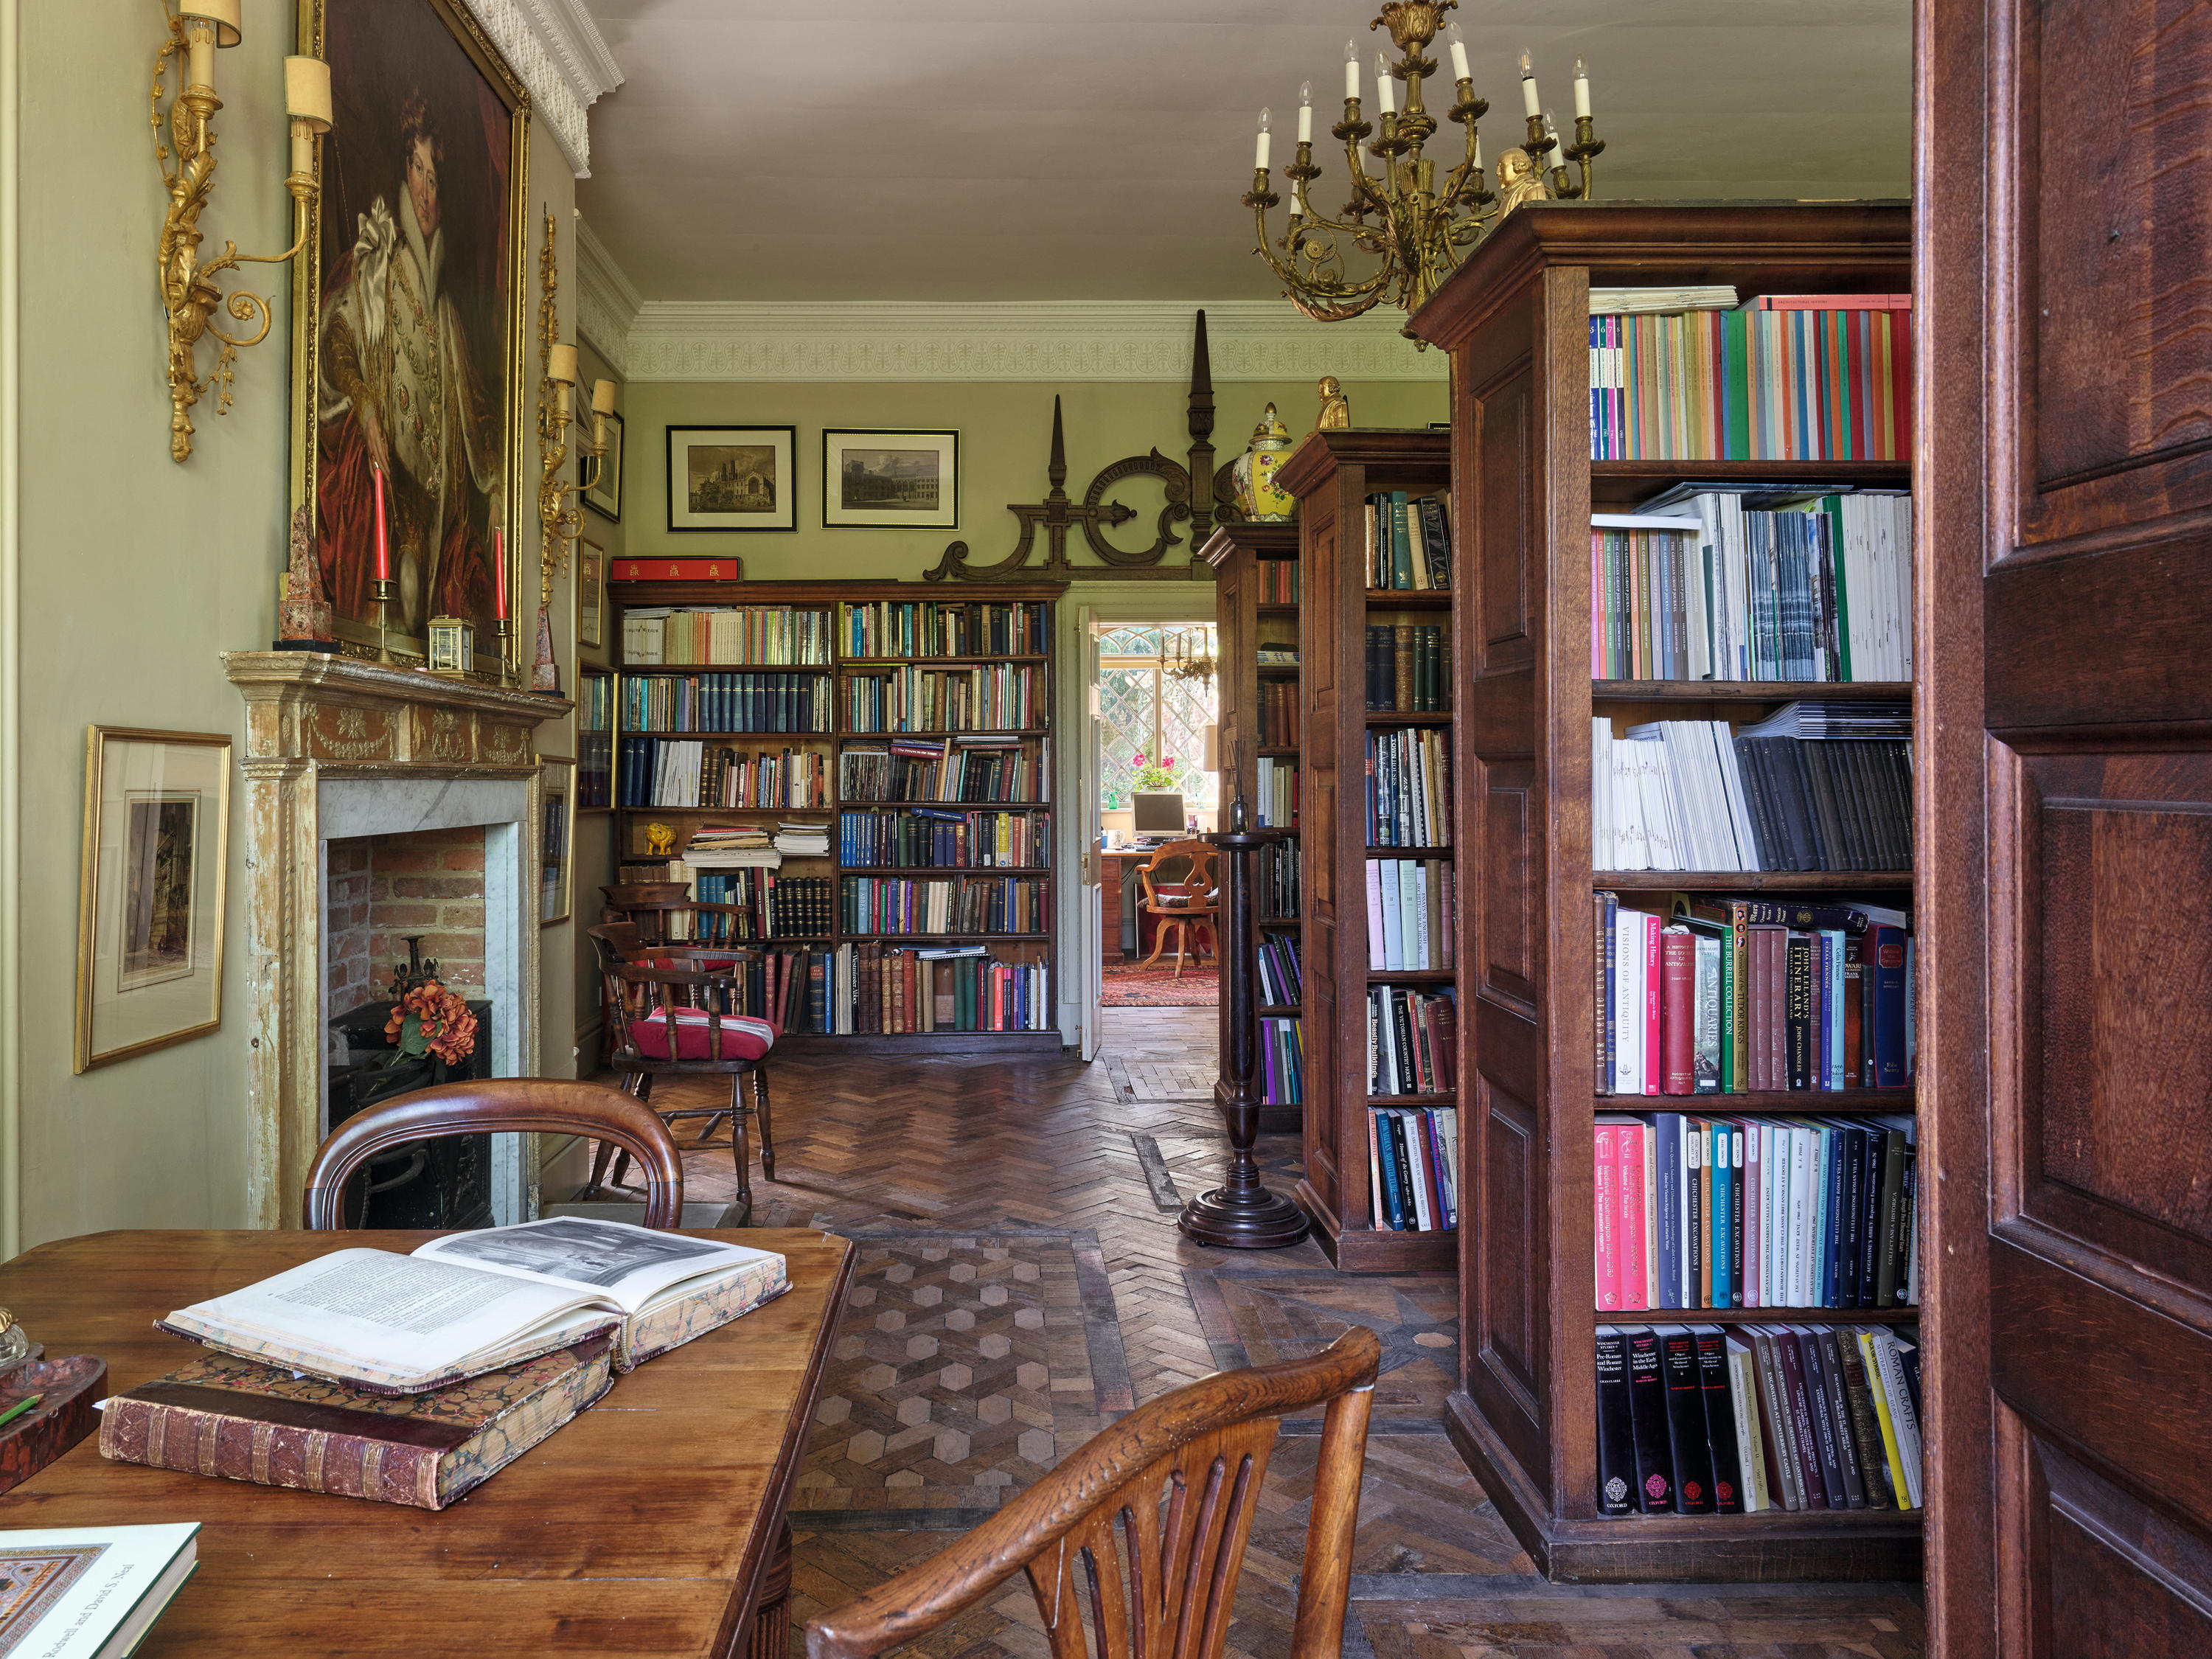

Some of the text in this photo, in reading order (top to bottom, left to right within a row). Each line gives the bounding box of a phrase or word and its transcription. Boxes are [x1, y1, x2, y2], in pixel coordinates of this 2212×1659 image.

[1622, 970, 1629, 982] OF
[1621, 986, 1629, 1041] ANTIQUITY
[1704, 967, 1717, 1046] ANTIQUARIES
[1380, 1119, 1398, 1192] EDWARDIAN ARCHITECTURE
[1411, 1136, 1419, 1169] ARCHITECTURE
[1603, 1197, 1612, 1241] Southampton
[1833, 1373, 1842, 1402] EXCAVATIONS
[1871, 1358, 1881, 1379] SYMBOL
[1886, 1341, 1916, 1430] ROMAN CRAFTS
[1798, 1382, 1806, 1411] EXCAVATIONS
[1818, 1384, 1826, 1412] CANTERBURY
[1766, 1372, 1778, 1410] EXCAVATIONS
[1775, 1419, 1787, 1457] CANTERBURY
[1782, 1458, 1791, 1479] CASTLE
[1778, 1371, 1788, 1405] EXCAVATIONS
[1788, 1426, 1797, 1453] DEFENCES
[1794, 1461, 1805, 1496] CANTERBURY
[42, 1628, 79, 1658] Rodwell
[75, 1613, 93, 1625] and
[84, 1590, 112, 1610] David
[111, 1564, 134, 1579] Neal
